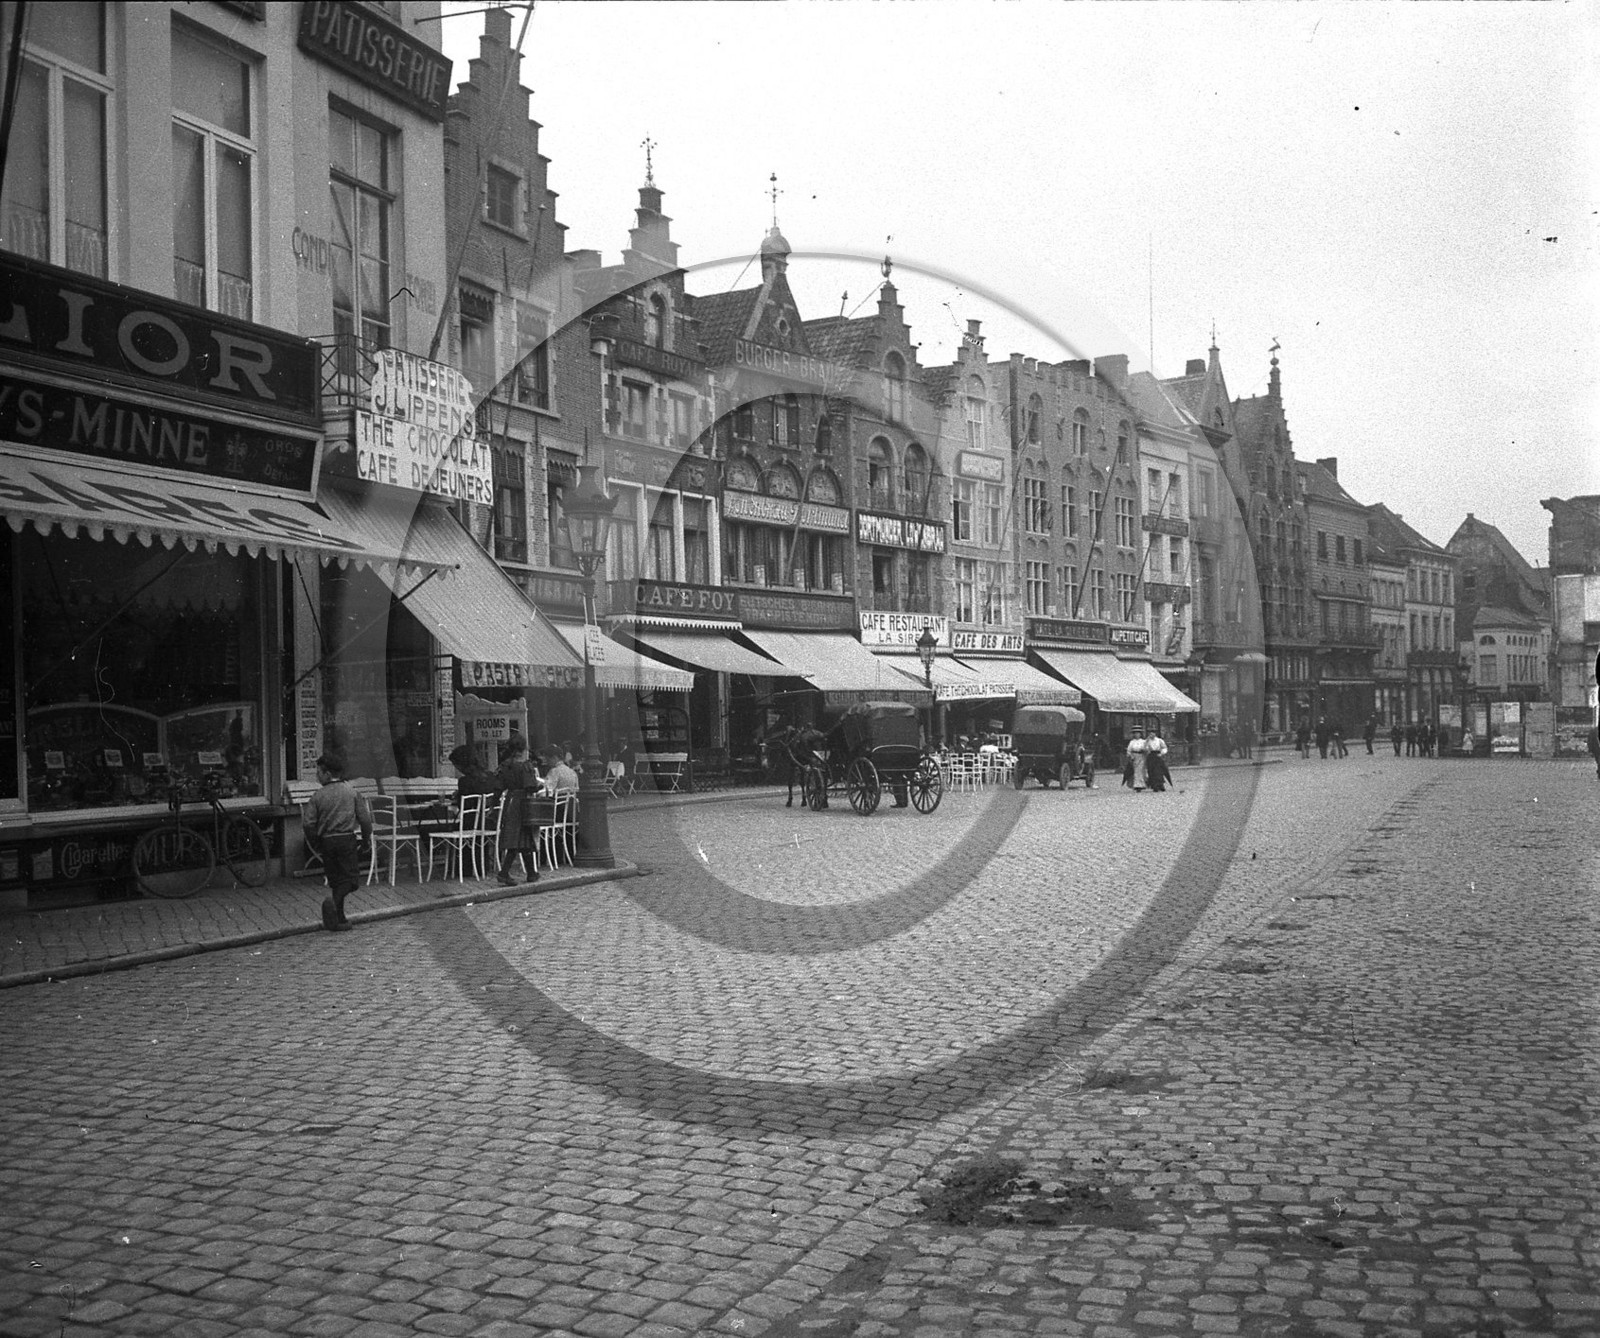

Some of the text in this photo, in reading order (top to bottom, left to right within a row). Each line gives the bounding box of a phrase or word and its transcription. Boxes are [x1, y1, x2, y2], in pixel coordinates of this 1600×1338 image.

[310, 1, 446, 107] PATISSERIE
[382, 350, 466, 406] PATISSERIE
[361, 412, 488, 471] THE CHOCOLAT
[698, 588, 735, 609] FOY
[861, 612, 946, 632] CAFE RESTAURANT
[878, 632, 921, 645] LA SIRE
[981, 634, 998, 649] DES
[1001, 635, 1023, 650] ARTS
[473, 662, 532, 686] PASTRY
[476, 718, 506, 729] ROOMS
[481, 730, 503, 738] TO LET
[61, 841, 130, 878] Cigarettes
